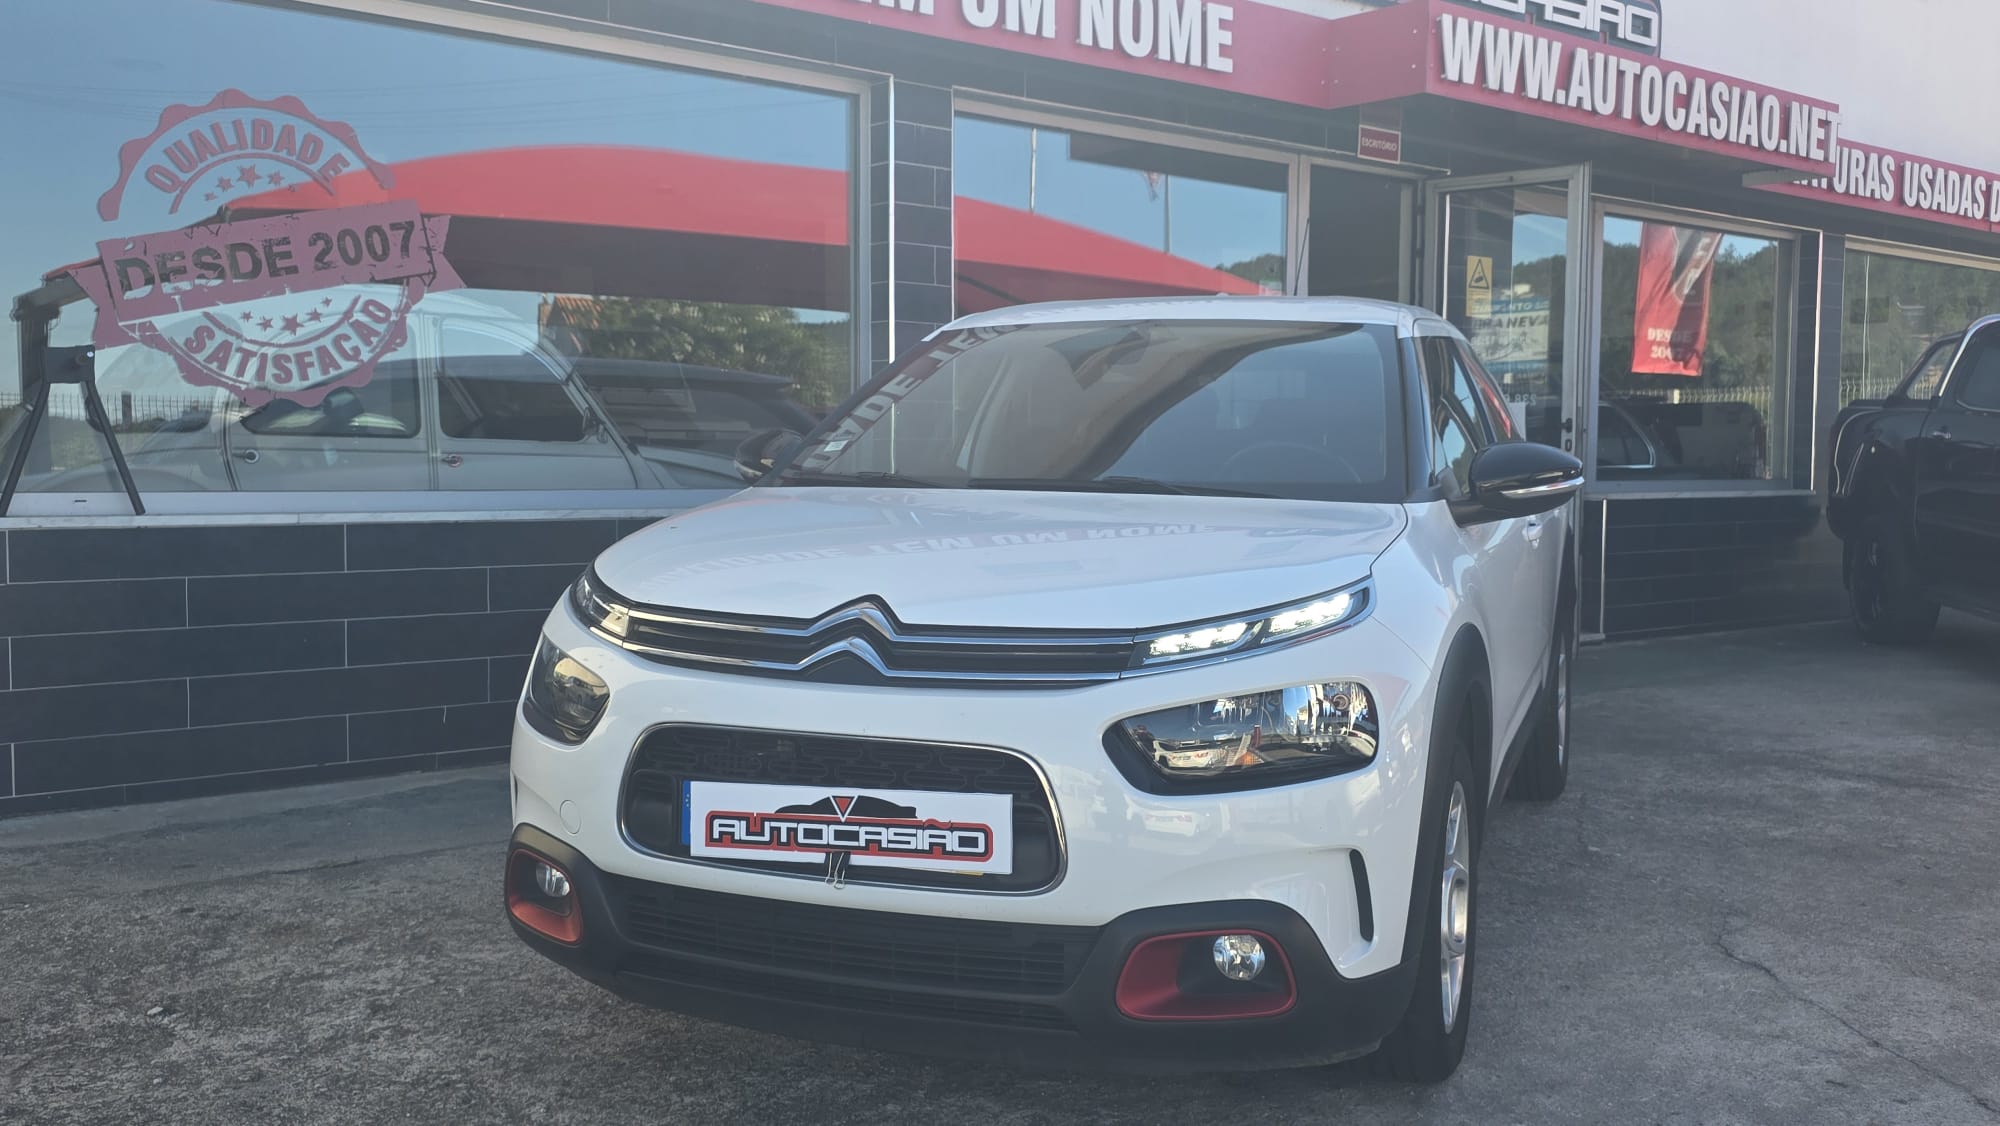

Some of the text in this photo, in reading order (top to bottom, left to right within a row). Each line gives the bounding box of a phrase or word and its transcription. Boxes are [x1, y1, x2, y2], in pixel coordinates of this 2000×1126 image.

[1079, 0, 1234, 73] NOME
[1441, 13, 1841, 164] WWW.AUTOCASIAO.NET
[1903, 160, 1987, 220] USADAS
[114, 220, 415, 300] DESDE 2007
